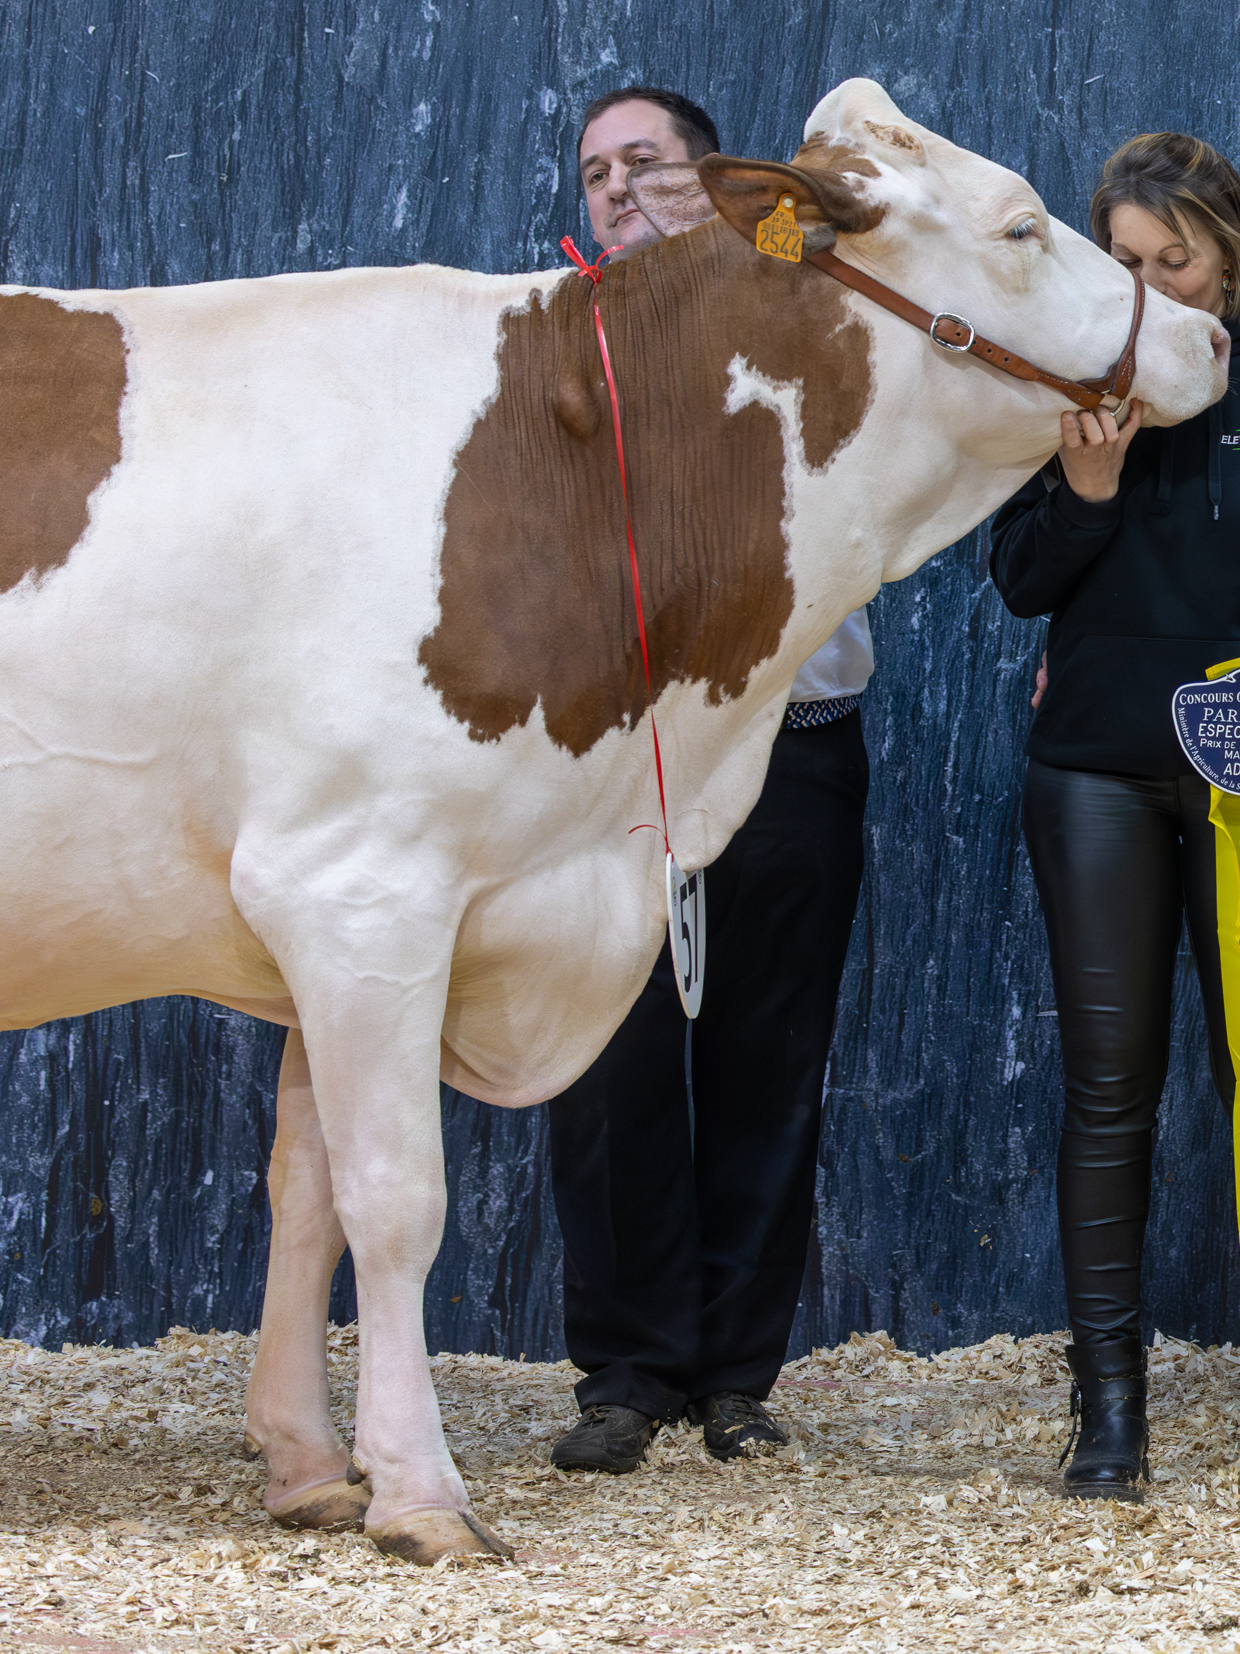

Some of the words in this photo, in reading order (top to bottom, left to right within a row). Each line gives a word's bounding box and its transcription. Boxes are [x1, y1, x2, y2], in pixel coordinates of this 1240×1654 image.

[760, 226, 801, 259] 2544
[1179, 693, 1234, 706] CONCOURS
[1177, 707, 1190, 738] Ministère
[1185, 738, 1194, 747] de
[1200, 738, 1222, 748] PRIX
[1224, 741, 1236, 749] DE
[1189, 745, 1219, 782] l'Agriculture,
[1220, 777, 1229, 786] de
[1228, 780, 1236, 788] la
[679, 873, 698, 993] 57
